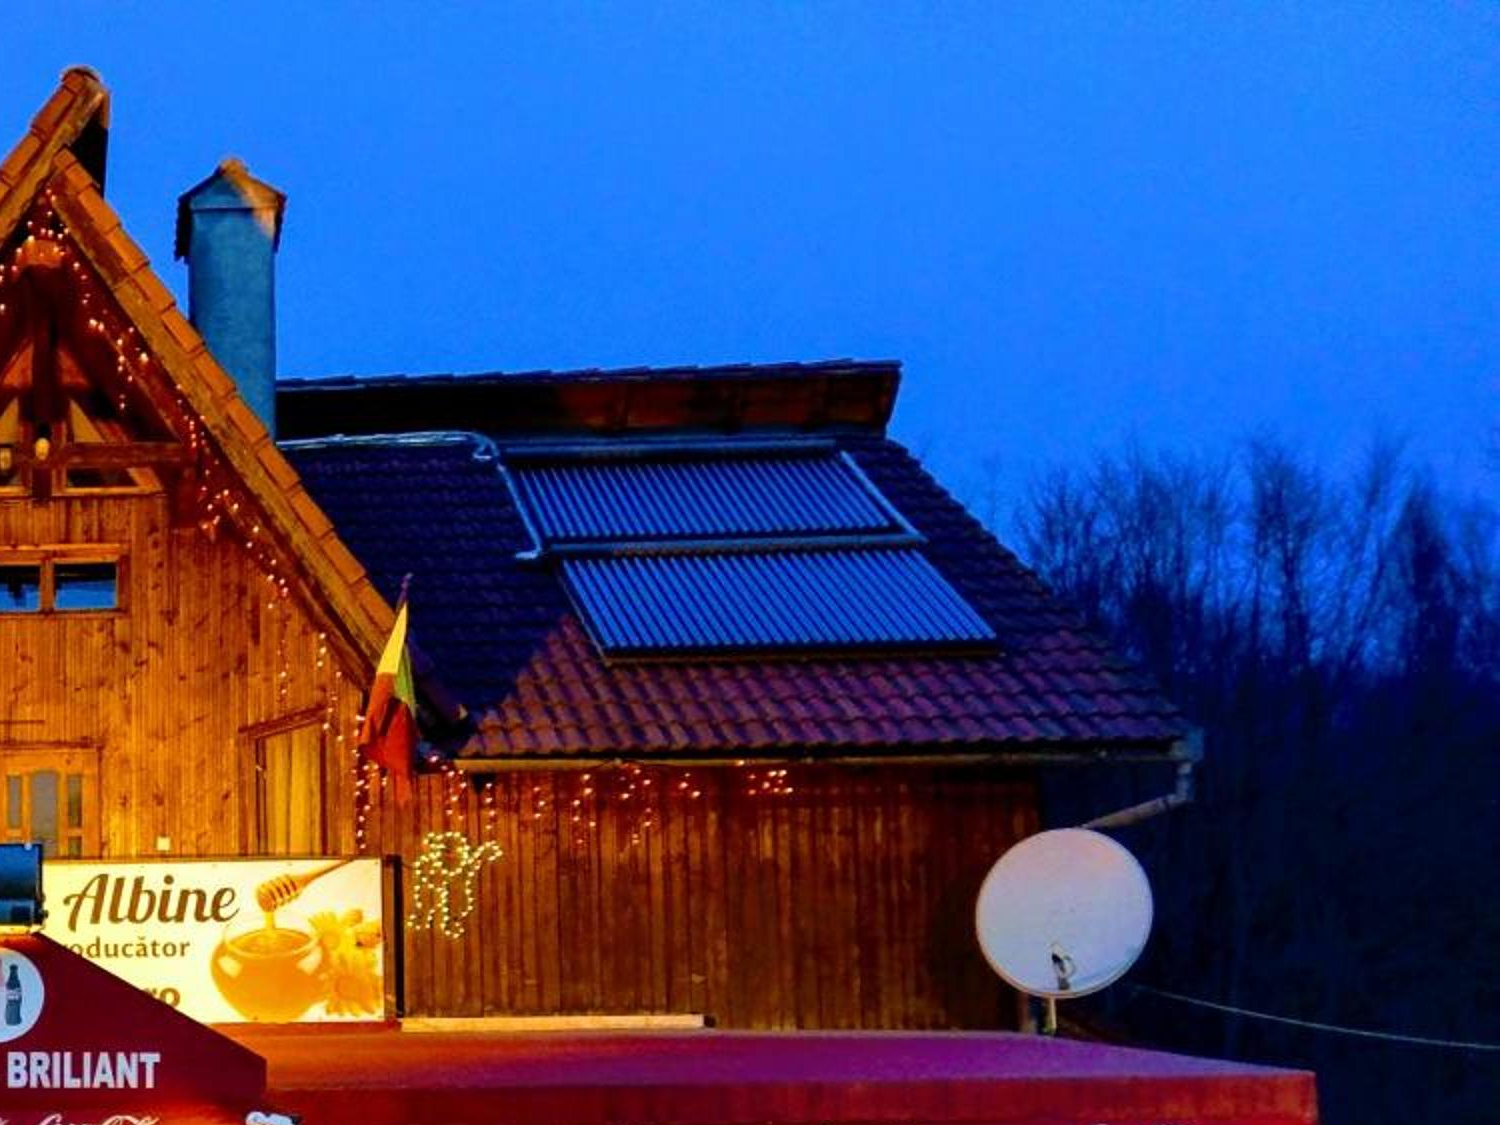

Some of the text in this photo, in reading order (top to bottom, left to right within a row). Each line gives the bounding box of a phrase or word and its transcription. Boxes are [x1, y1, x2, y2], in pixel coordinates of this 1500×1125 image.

[62, 873, 240, 932] Albine
[65, 935, 191, 958] oducător
[7, 1051, 161, 1089] BRILIANT
